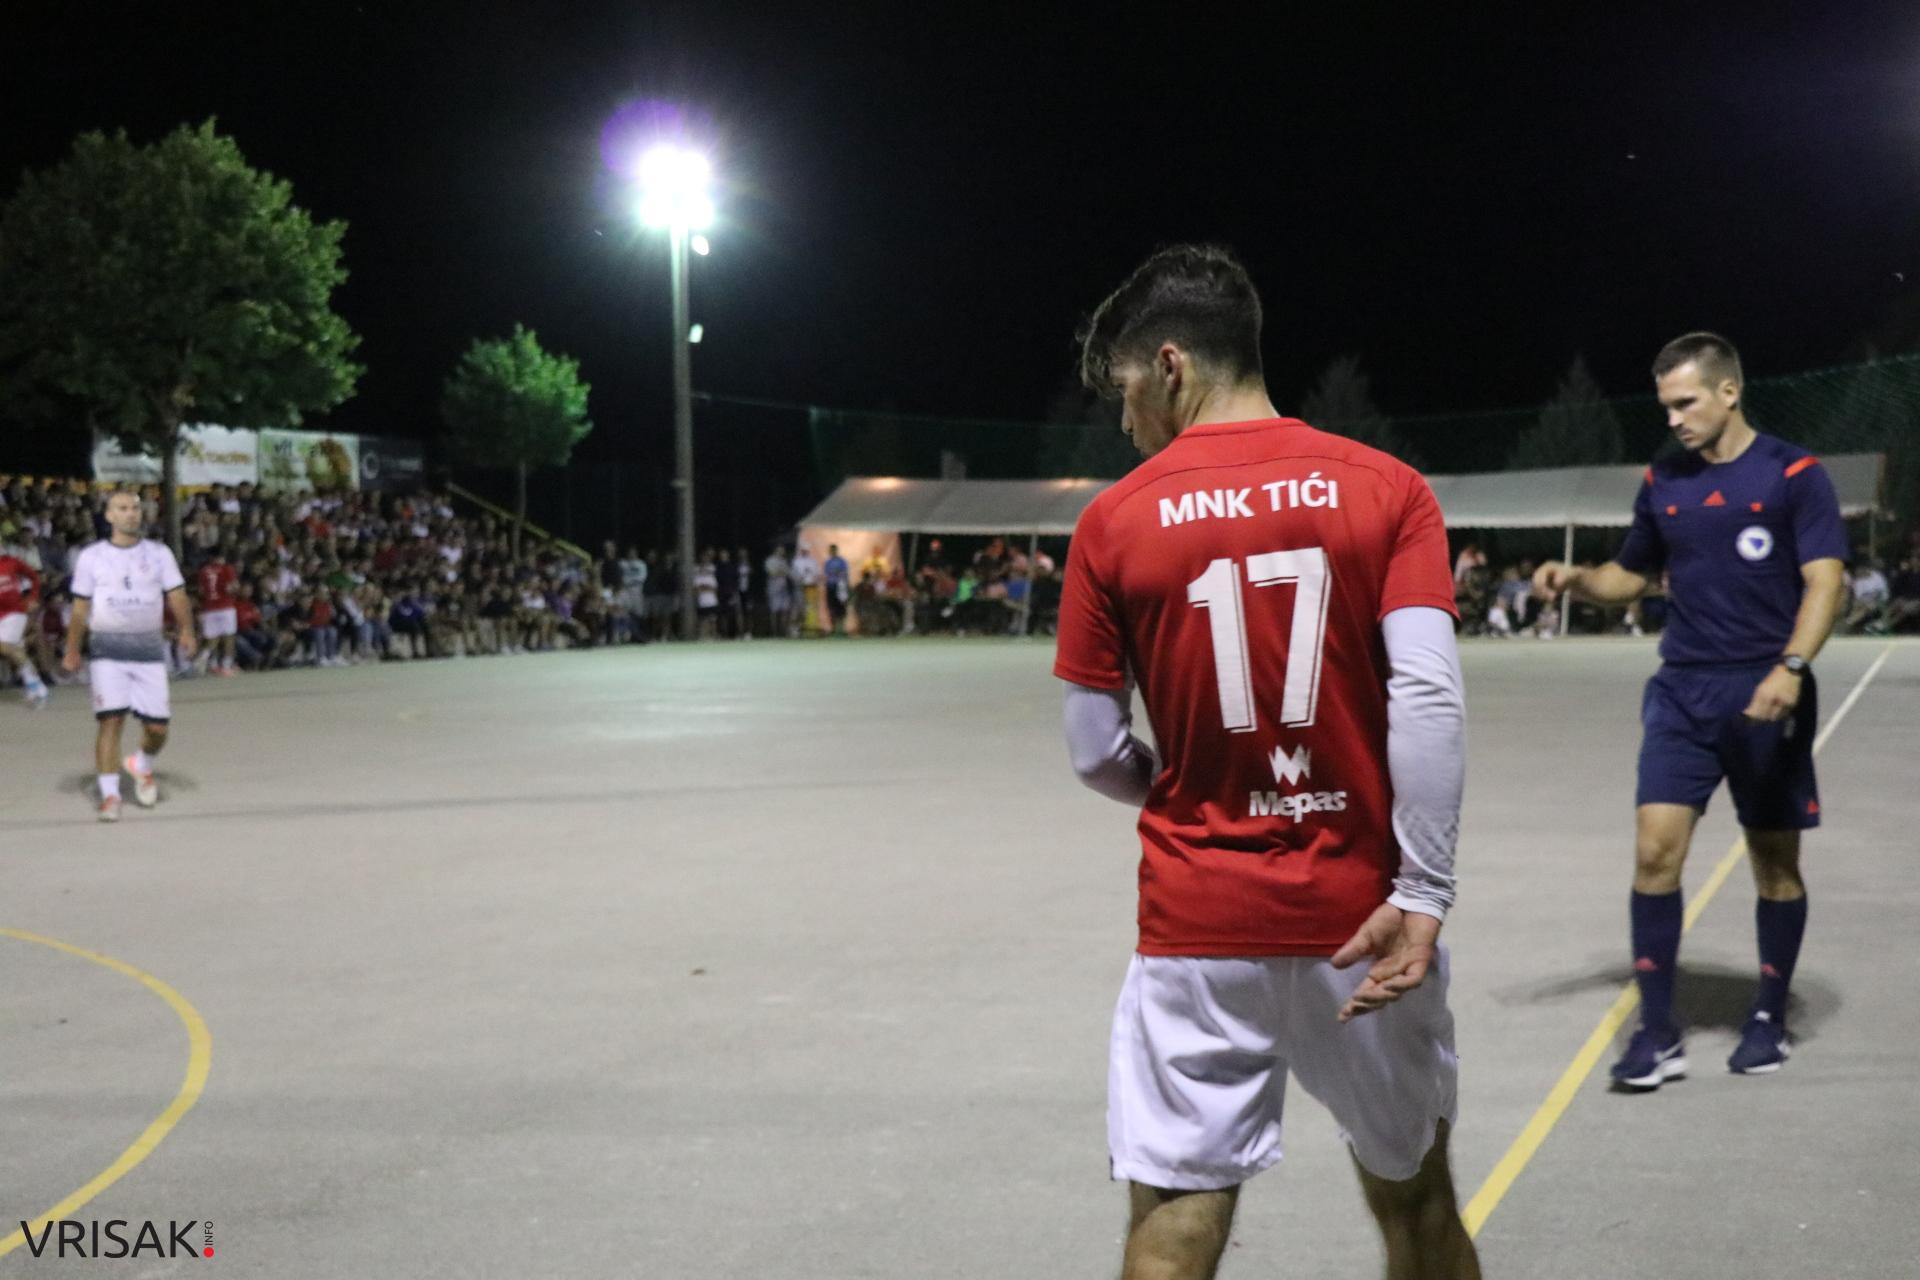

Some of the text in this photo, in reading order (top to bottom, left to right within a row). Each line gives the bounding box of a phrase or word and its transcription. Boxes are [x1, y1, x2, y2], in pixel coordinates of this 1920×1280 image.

[1158, 472, 1339, 528] MNK TIĆI
[1187, 546, 1331, 734] 17
[1249, 790, 1347, 823] Mepas
